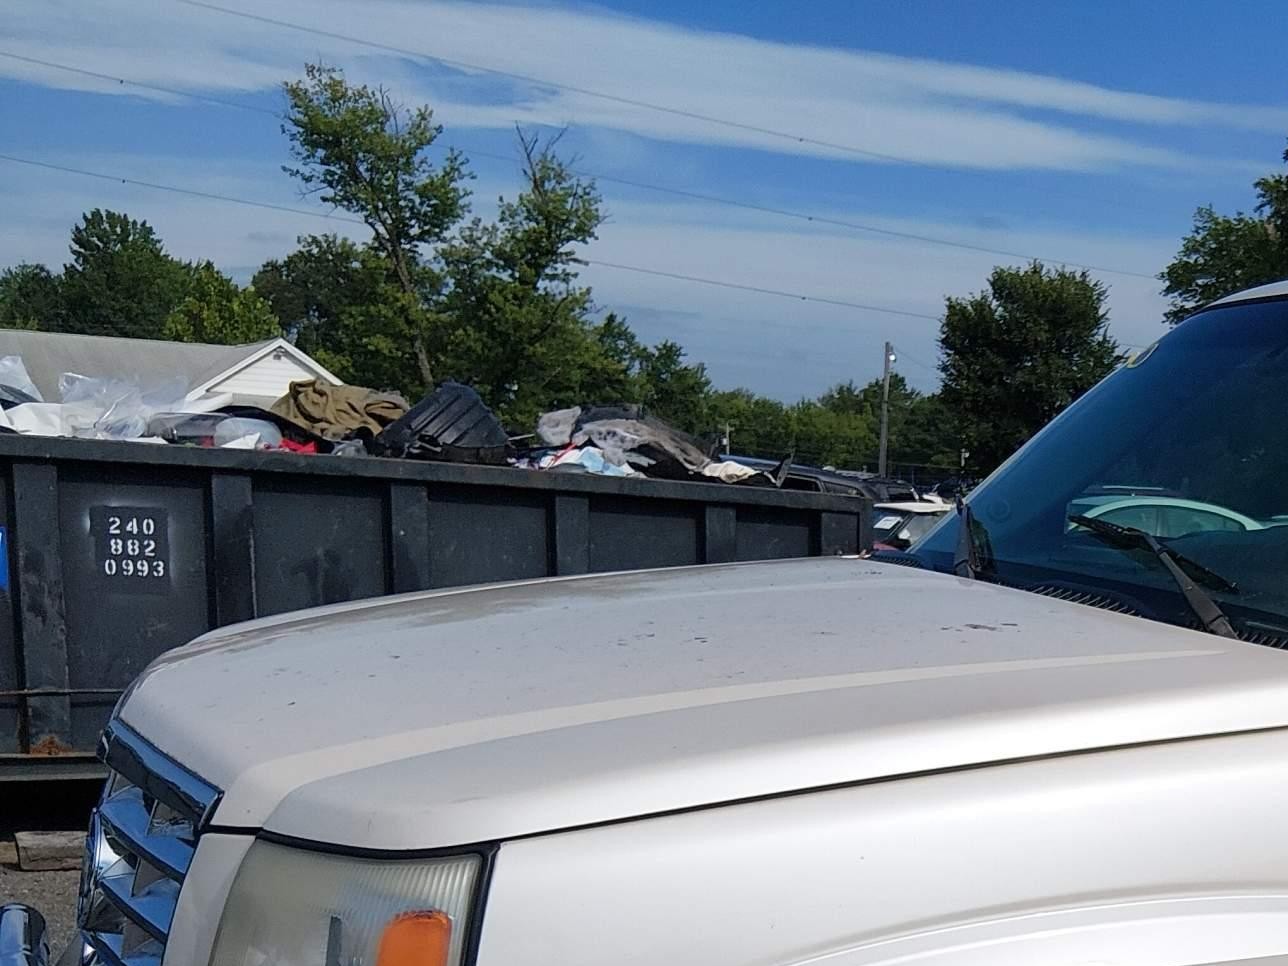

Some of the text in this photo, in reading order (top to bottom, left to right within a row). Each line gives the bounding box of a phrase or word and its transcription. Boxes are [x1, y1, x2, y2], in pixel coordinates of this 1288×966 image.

[108, 517, 155, 535] 240
[110, 538, 156, 557] 882
[104, 559, 164, 577] 0993
